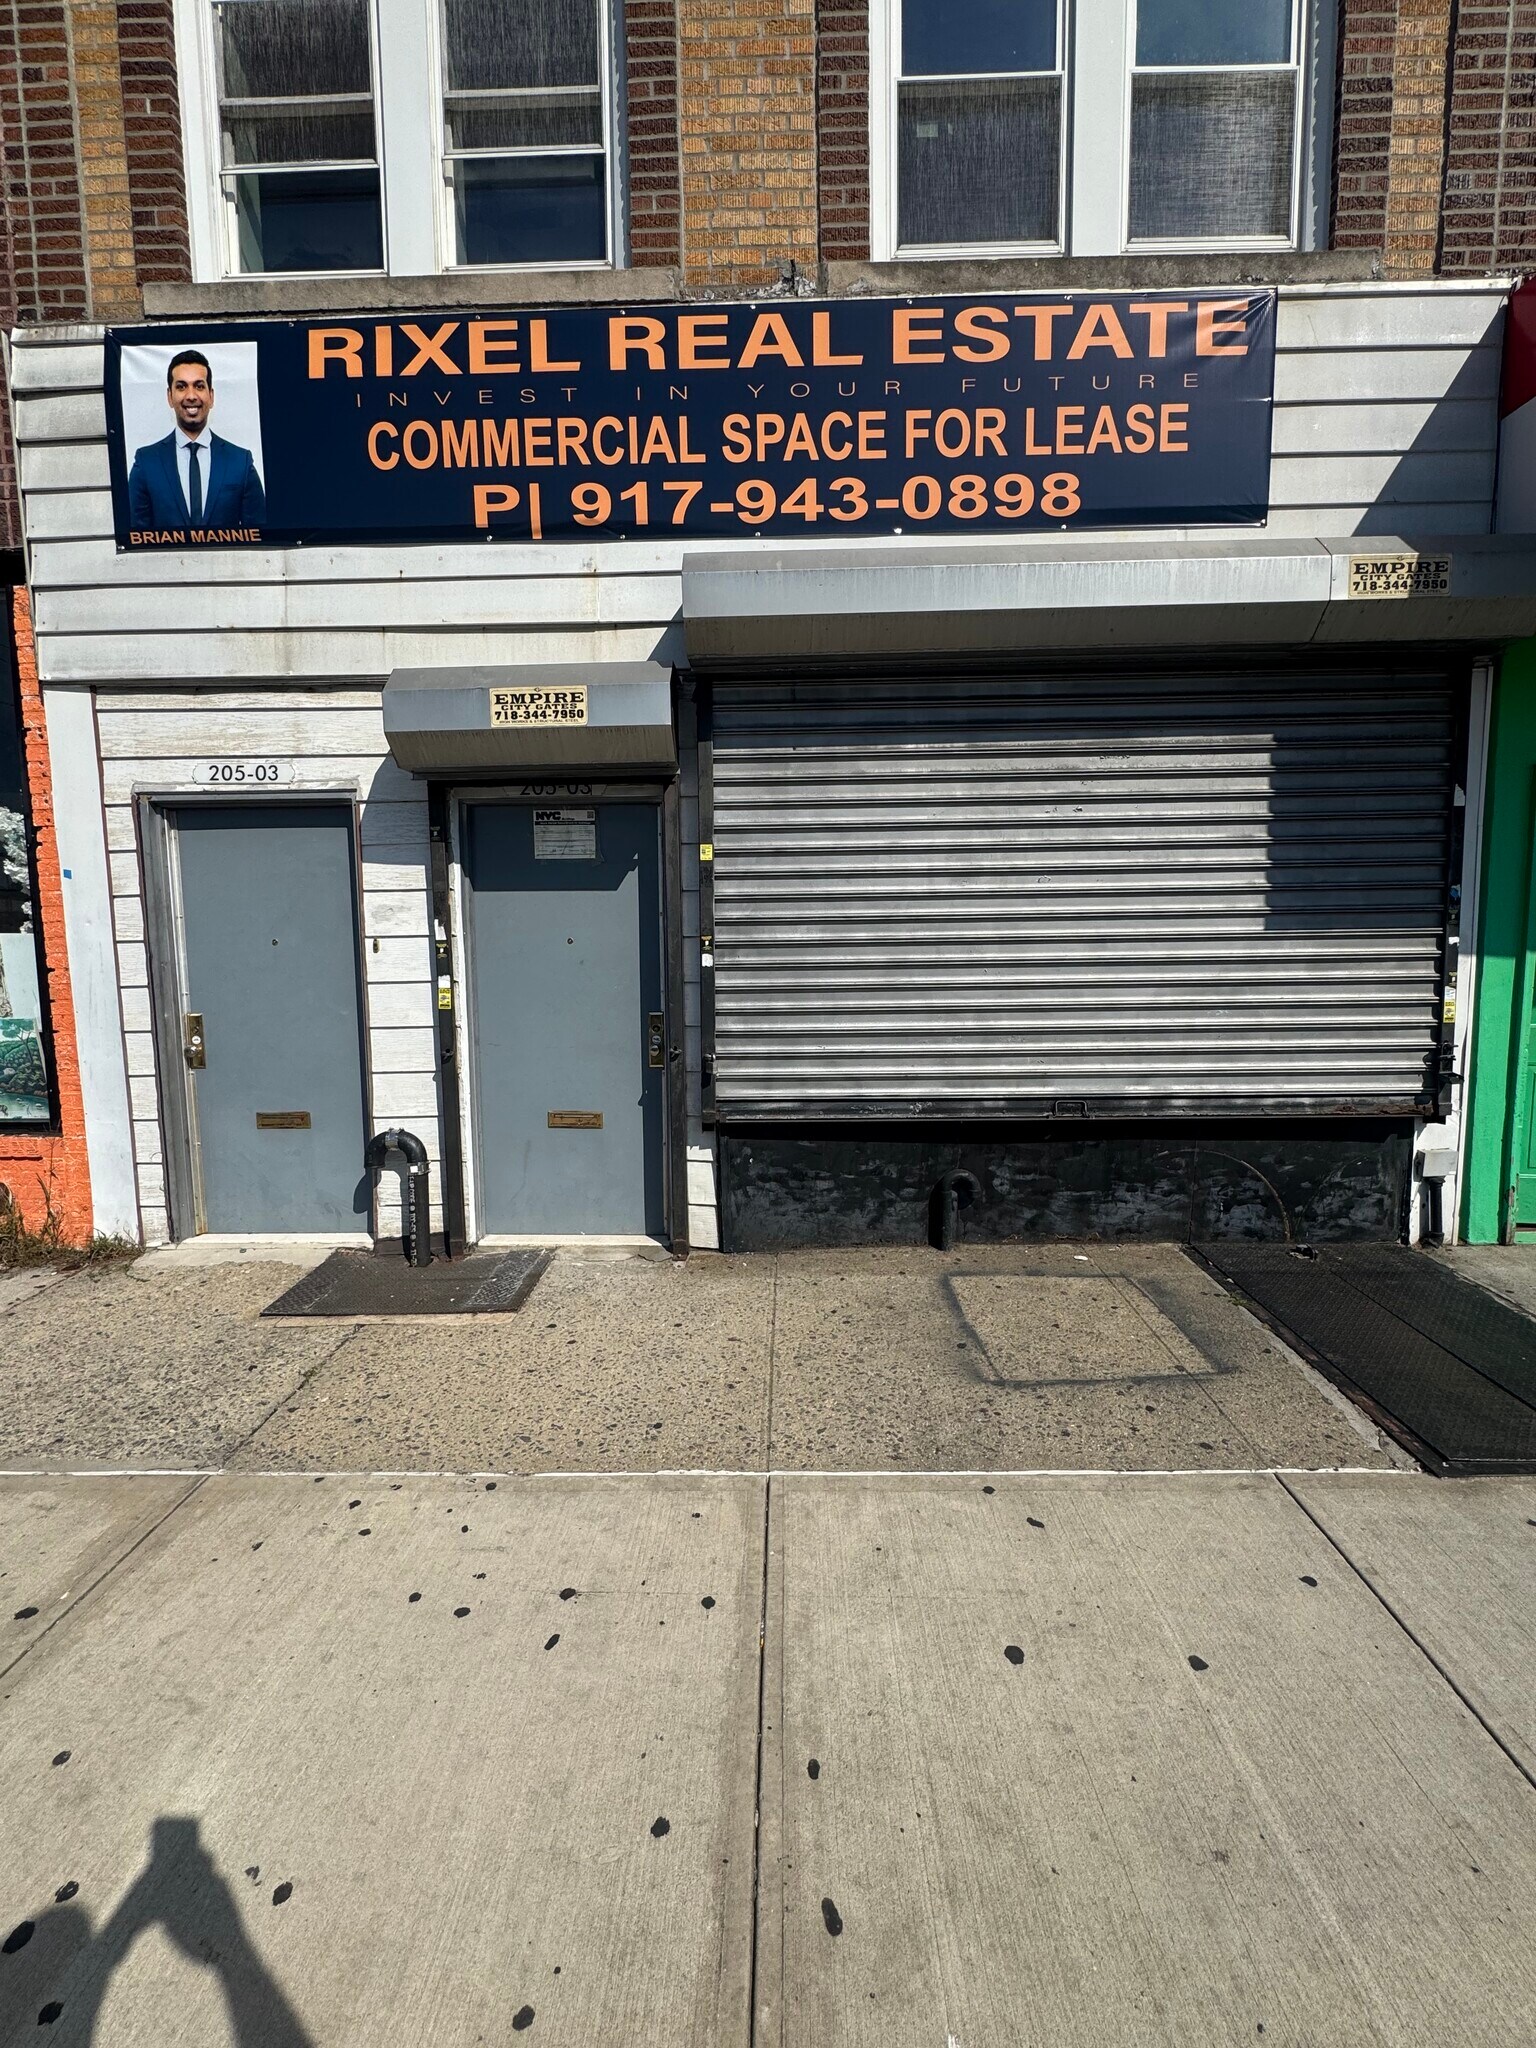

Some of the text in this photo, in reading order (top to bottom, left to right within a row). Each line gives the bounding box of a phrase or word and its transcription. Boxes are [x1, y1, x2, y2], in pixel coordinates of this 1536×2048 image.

[308, 301, 1249, 379] RIXEL REAL ESTATE
[357, 373, 1199, 408] INVEST IN YOUR FUTURE
[367, 403, 1189, 471] COMMERCIAL SPACE FOR LEASE
[570, 472, 1082, 527] 917-943-0898
[130, 529, 262, 545] BRIAN MANNIE
[1353, 561, 1449, 574] EMPIRE
[1353, 579, 1448, 591] 718-344-7950
[494, 692, 584, 704] EMPIRE
[494, 709, 585, 720] 718-344-7950
[208, 764, 279, 781] 205-03
[535, 811, 562, 821] NYC
